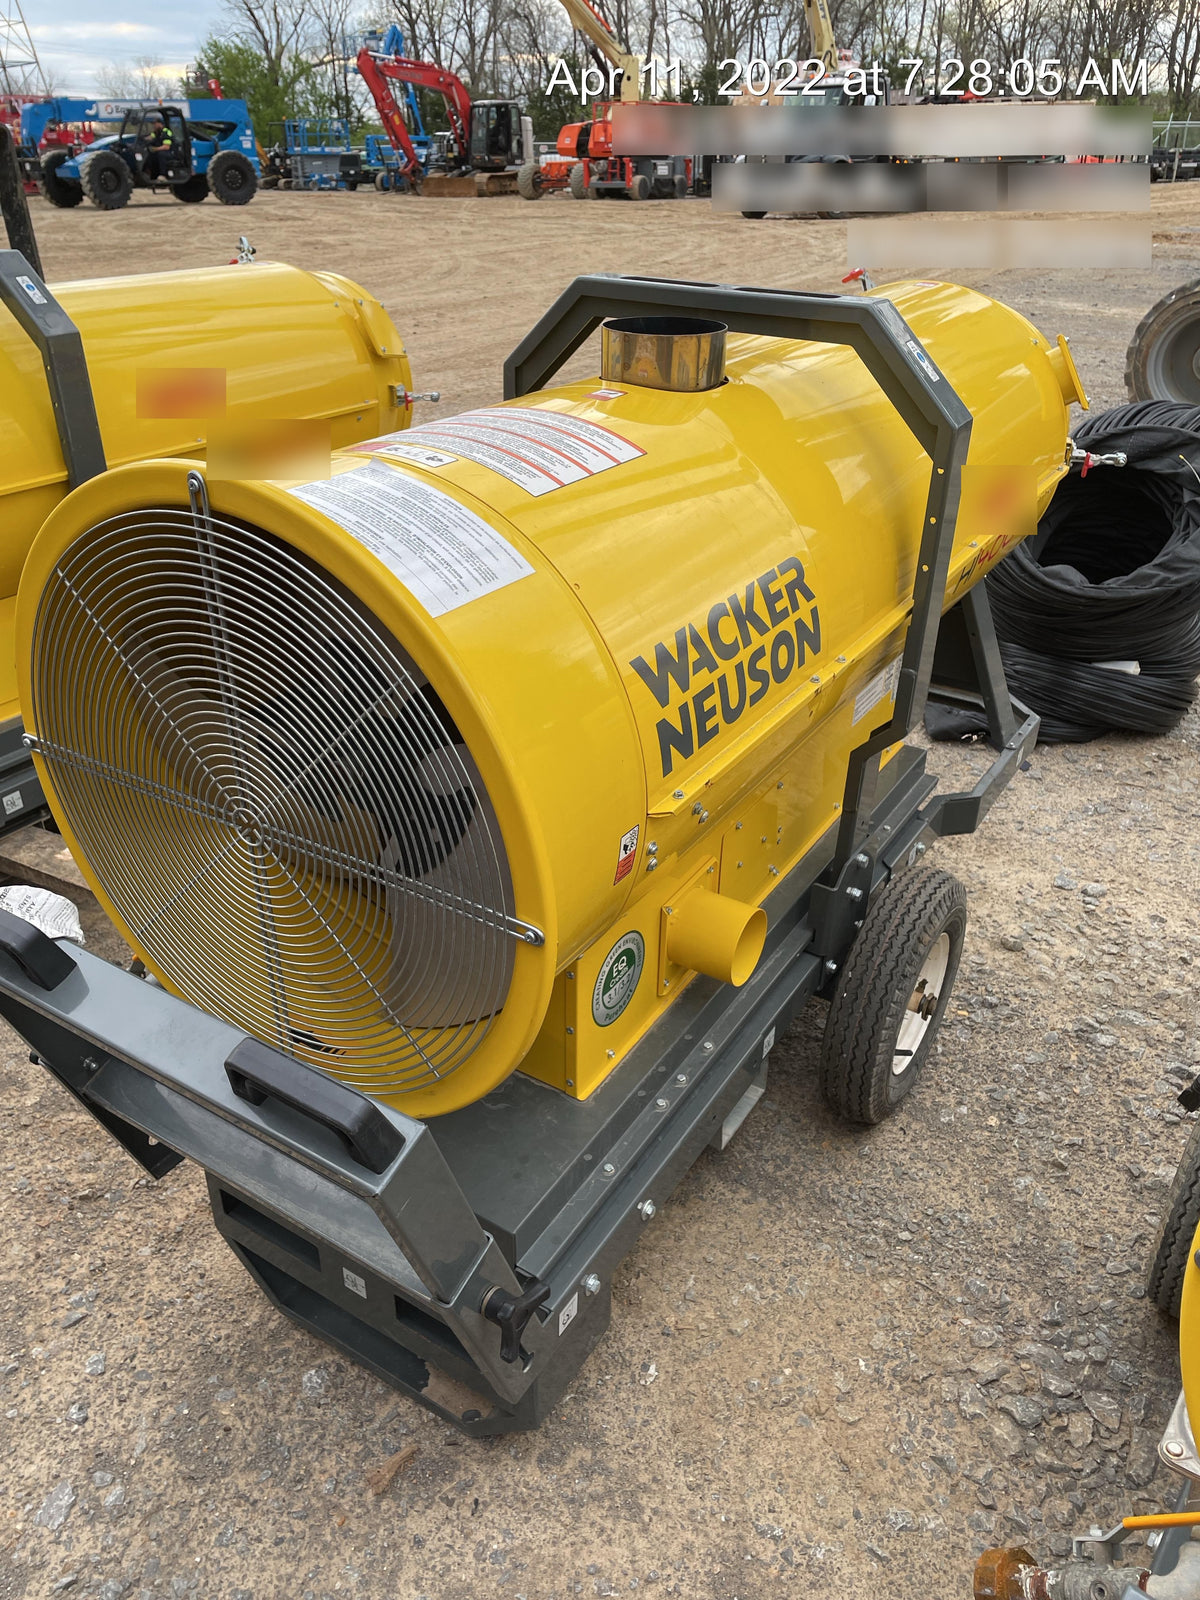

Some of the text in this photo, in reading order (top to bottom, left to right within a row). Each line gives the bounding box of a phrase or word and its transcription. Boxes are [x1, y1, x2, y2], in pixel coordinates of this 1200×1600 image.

[629, 557, 816, 708] WACKER
[656, 605, 821, 778] NEUSON
[612, 955, 627, 978] EQ
